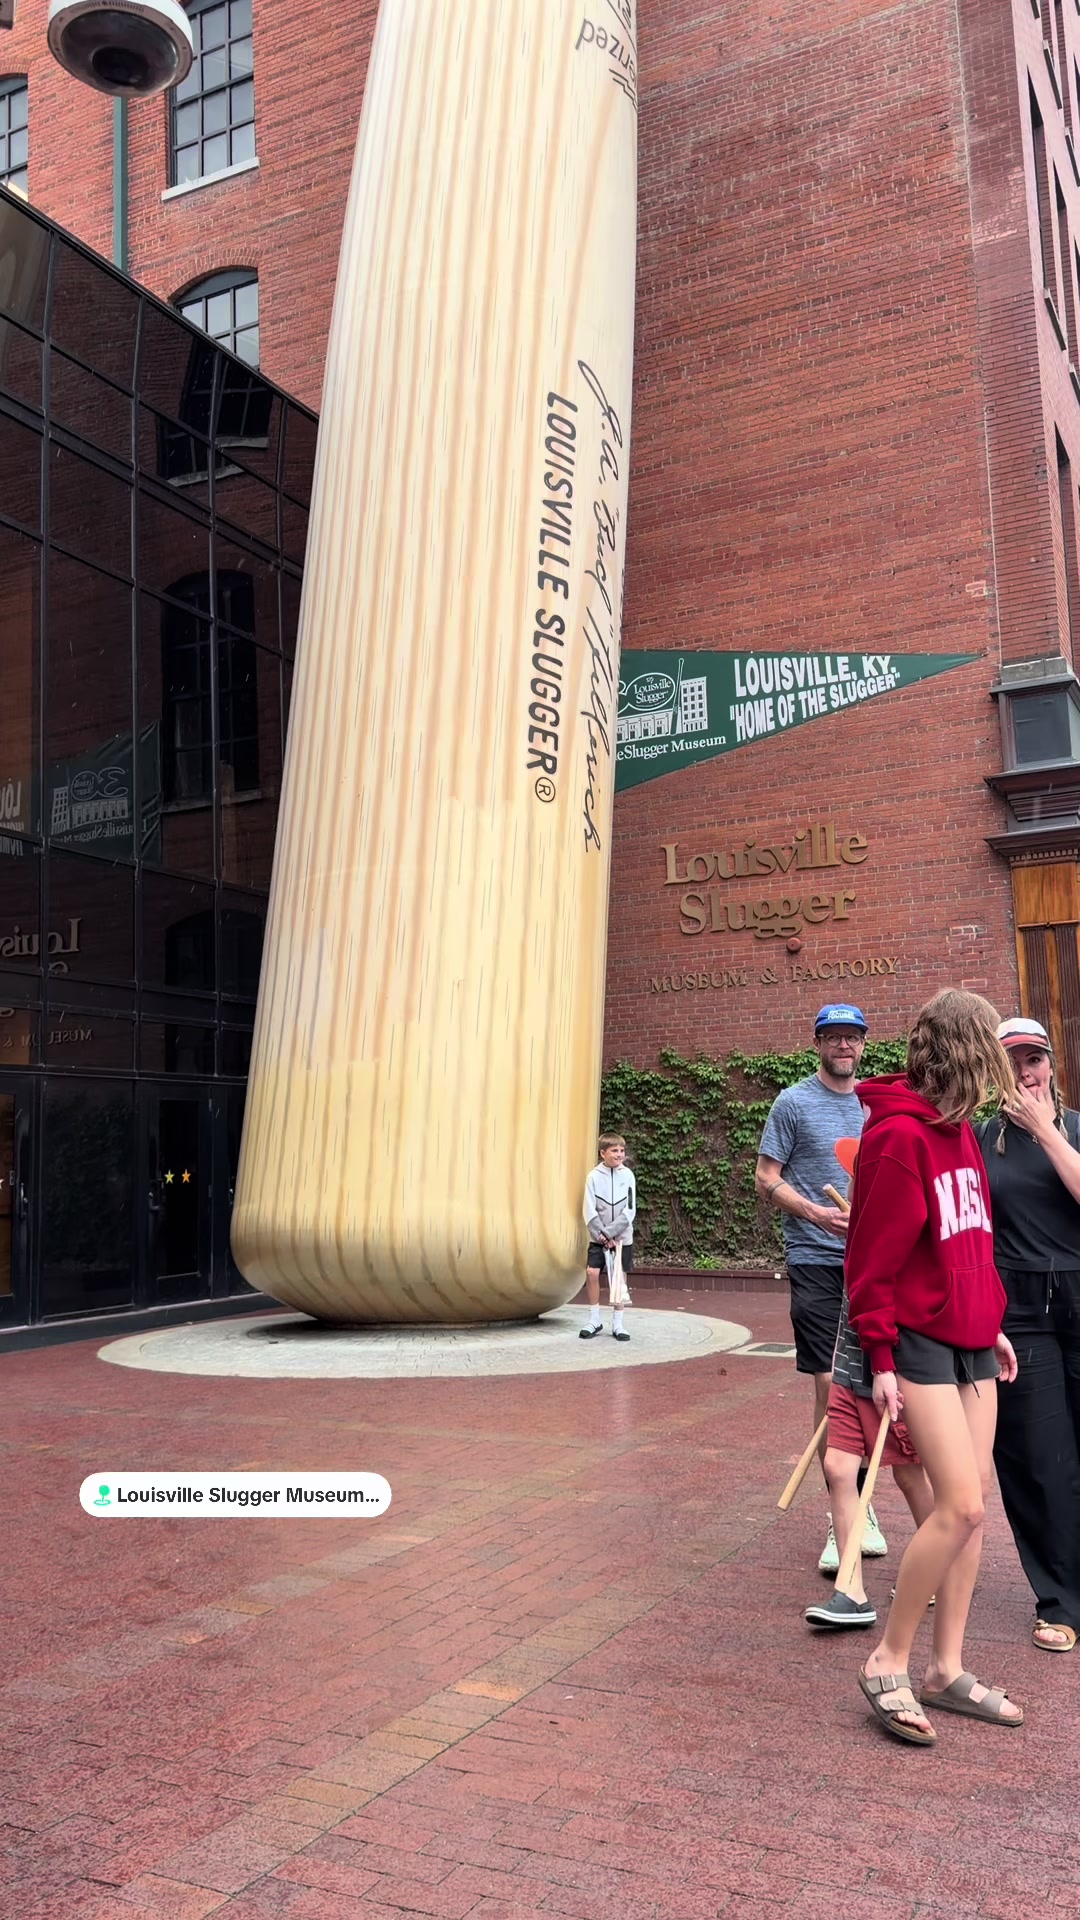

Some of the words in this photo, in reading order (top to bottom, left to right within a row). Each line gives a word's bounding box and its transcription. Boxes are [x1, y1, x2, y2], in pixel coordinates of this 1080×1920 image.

[537, 391, 578, 600] LOUISVILLE
[634, 678, 671, 694] Louisville
[777, 693, 795, 727] OF
[798, 687, 827, 719] THE
[580, 606, 613, 853] Hillerich
[616, 743, 668, 760] eSlugger
[670, 735, 727, 753] Museum
[661, 820, 869, 885] Louisville
[679, 885, 856, 939] Slugger
[650, 969, 747, 994] MUSEUM
[760, 967, 778, 985] &
[791, 956, 899, 982] FACTORY
